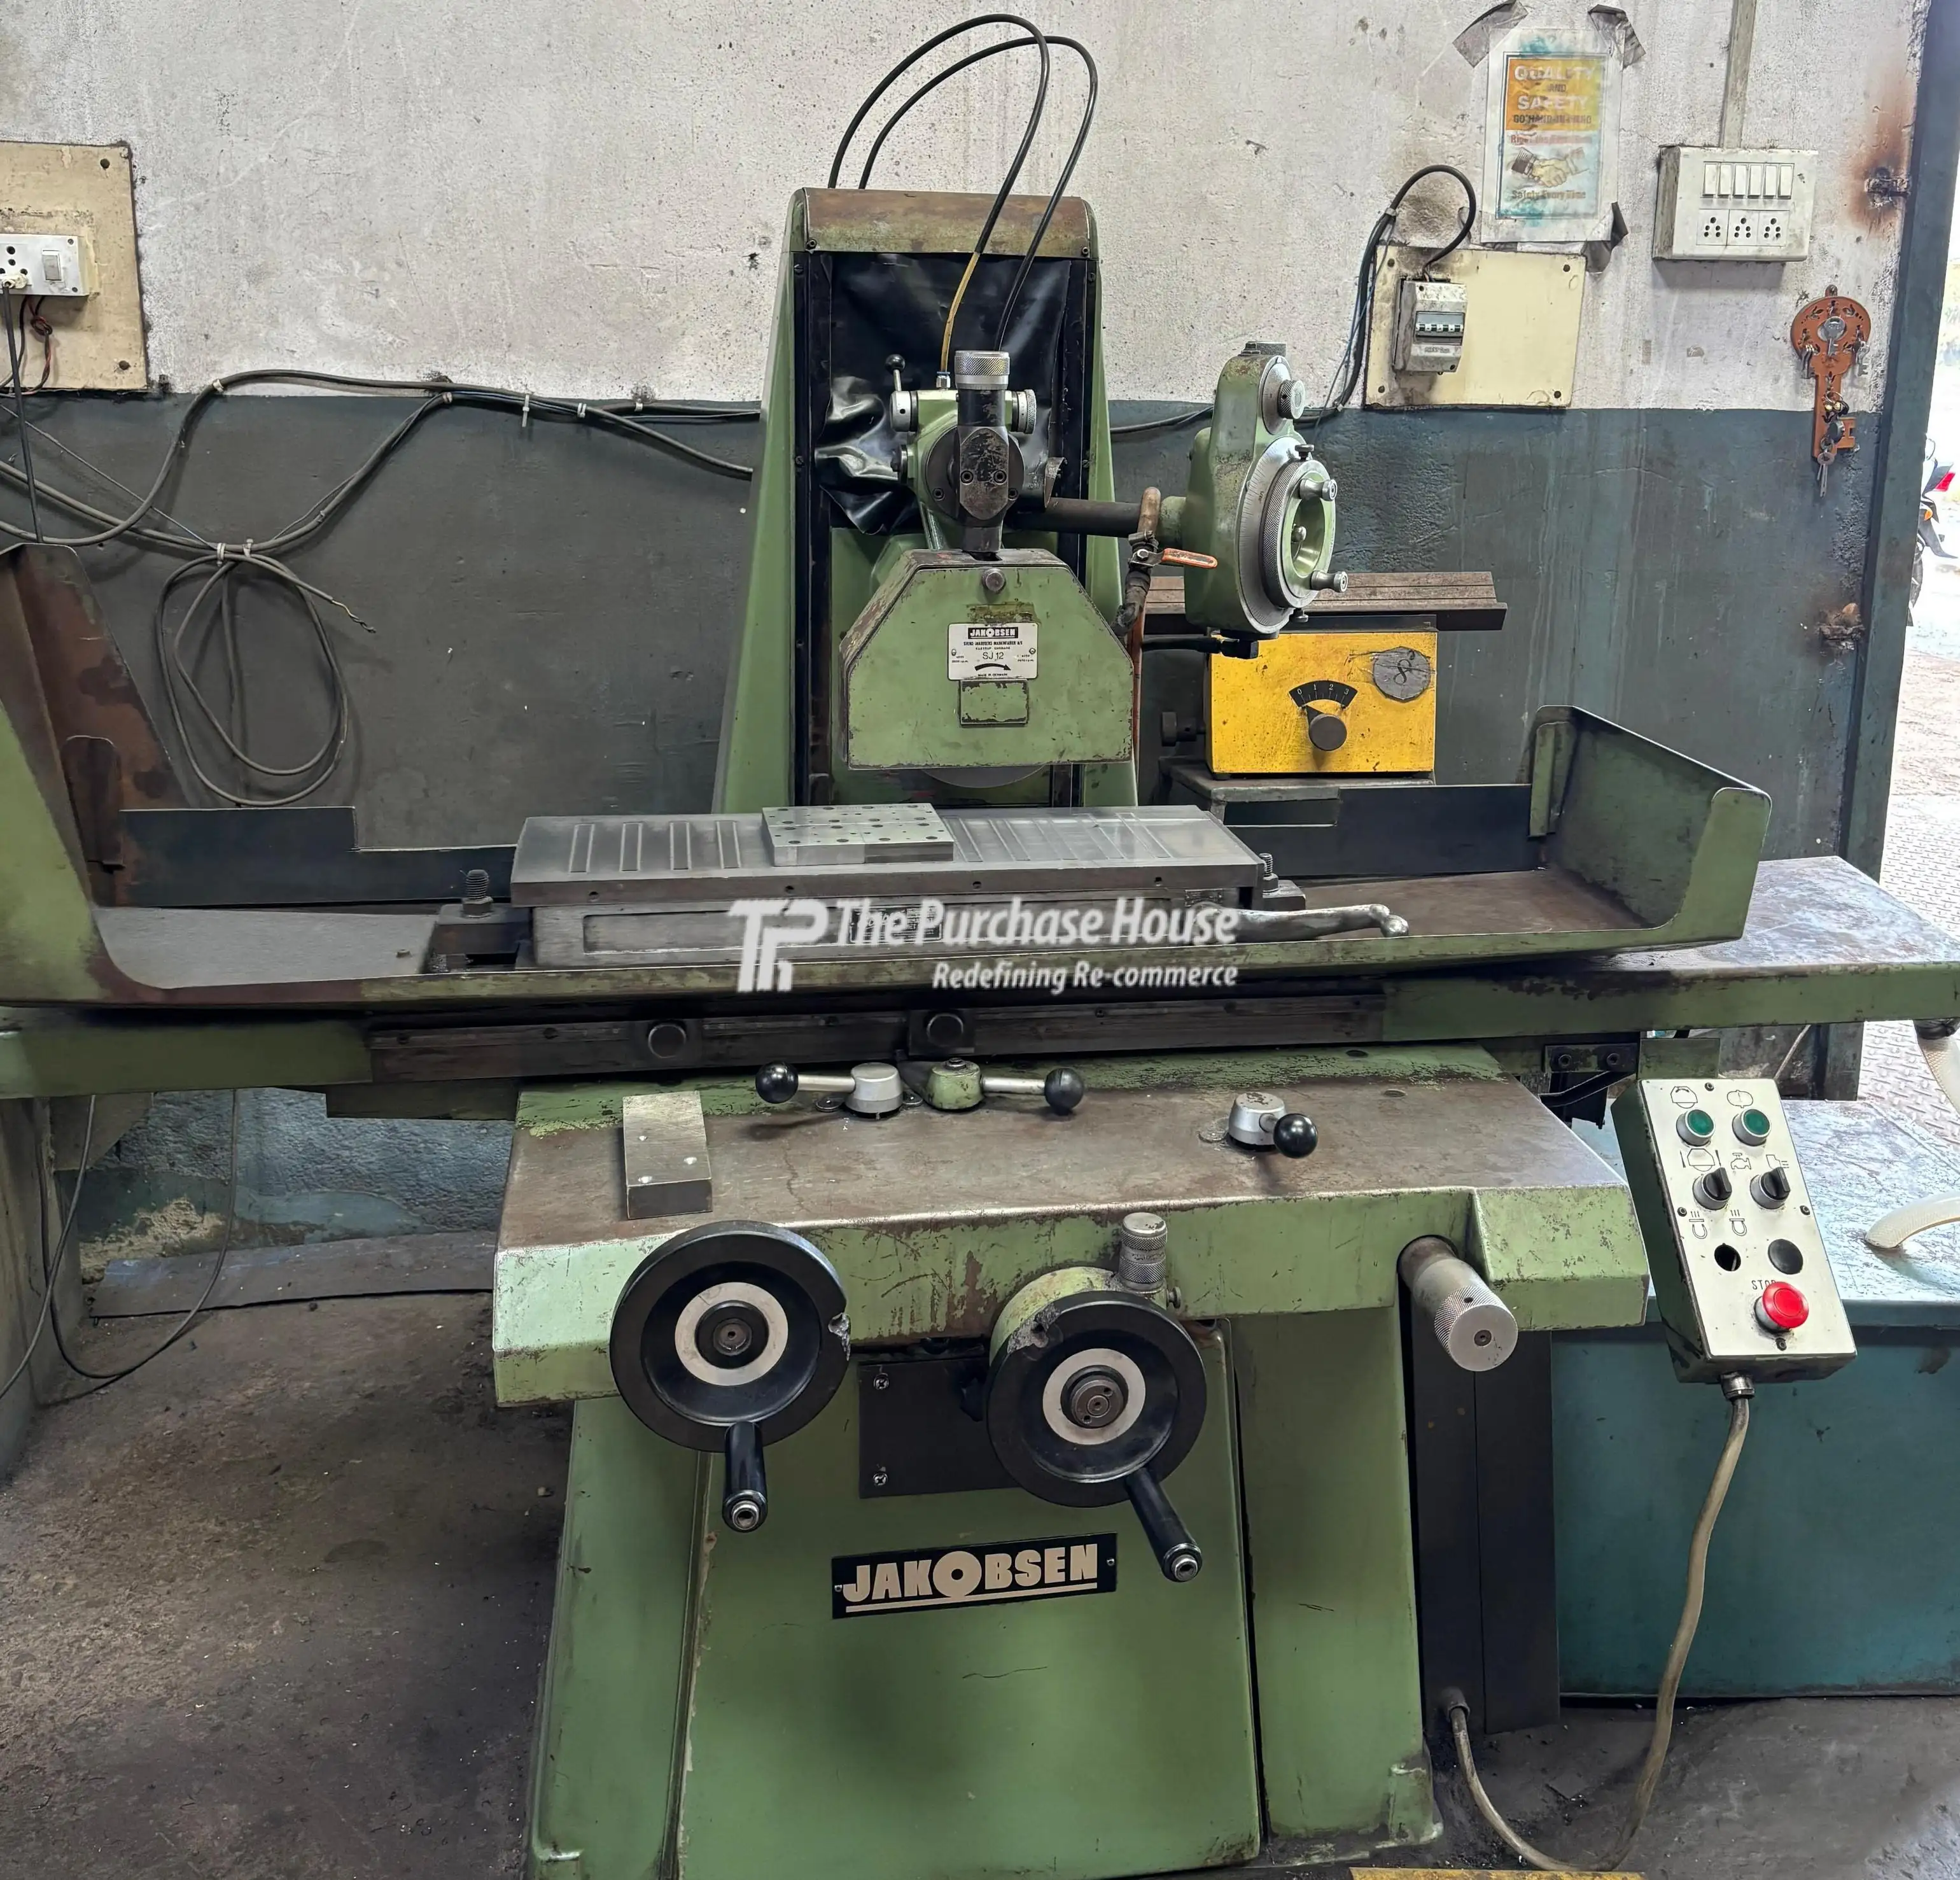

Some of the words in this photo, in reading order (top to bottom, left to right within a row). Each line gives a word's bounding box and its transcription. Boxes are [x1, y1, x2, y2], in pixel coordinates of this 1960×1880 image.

[1548, 84, 1567, 92] AND
[1517, 95, 1588, 110] SAFETY
[1513, 115, 1525, 123] GO
[970, 628, 1016, 637] JAKOBSEN
[843, 1543, 1098, 1603] JAKOBSEN
